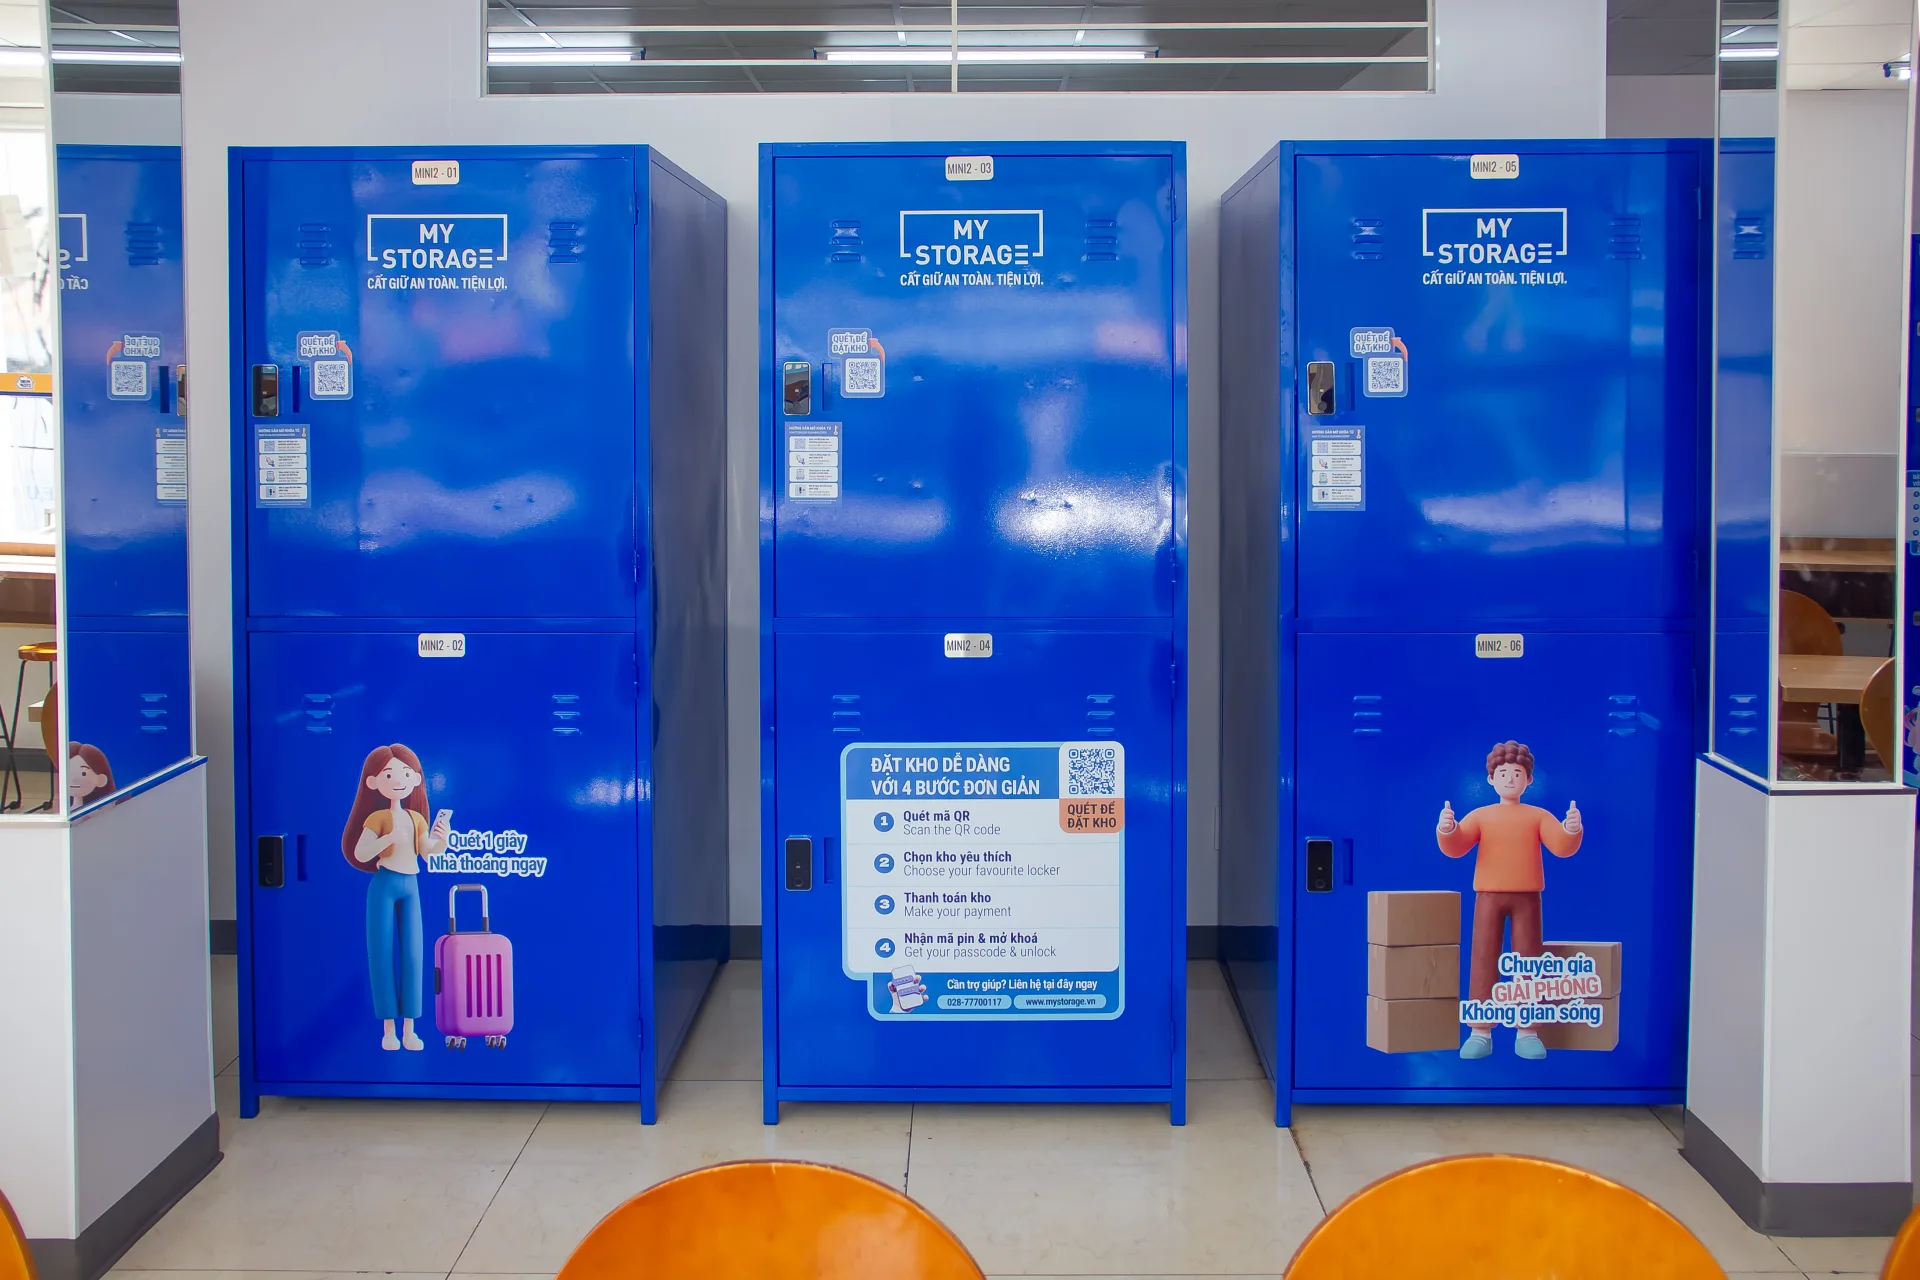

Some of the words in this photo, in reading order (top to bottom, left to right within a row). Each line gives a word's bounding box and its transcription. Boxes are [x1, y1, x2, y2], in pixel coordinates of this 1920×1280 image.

[415, 167, 438, 179] MINI2
[447, 167, 457, 179] 01
[948, 163, 971, 174] MINI2
[980, 163, 991, 174] 03
[1472, 162, 1496, 173] MINI2
[1506, 161, 1516, 173] 05
[420, 224, 454, 243] MY
[955, 220, 988, 239] MY
[1477, 218, 1511, 238] MY
[383, 249, 493, 268] STORAGE
[916, 245, 1028, 264] STORAGE
[1439, 244, 1552, 263] STORAGE
[368, 274, 388, 290] CẤT
[389, 275, 410, 290] GIỮ
[411, 279, 426, 290] AN
[427, 275, 459, 290] TOÀN.
[462, 276, 487, 291] TIỆN
[488, 277, 507, 291] LỢI.
[900, 269, 920, 286] CẤT
[922, 271, 944, 285] GIỮ
[945, 274, 959, 285] AN
[961, 270, 994, 285] TOÀN.
[996, 272, 1021, 287] TIỆN
[1024, 273, 1043, 287] LỢI.
[1423, 268, 1444, 285] CẤT
[1445, 270, 1466, 284] GIỮ
[1467, 273, 1483, 284] AN
[1485, 269, 1517, 284] TOÀN.
[1520, 271, 1545, 286] TIỆN
[1547, 272, 1567, 286] LỢI.
[302, 348, 317, 356] ĐẶT
[833, 344, 848, 353] ĐẶT
[1356, 344, 1370, 352] ĐẶT
[421, 640, 443, 651] MINI2
[452, 640, 463, 650] 02
[947, 640, 970, 651] MINI2
[980, 640, 990, 651] 04
[1478, 640, 1501, 651] MINI2
[1510, 640, 1521, 651] 06
[871, 754, 902, 776] ĐẶT
[905, 758, 938, 773] KHO
[943, 752, 963, 773] DỄ
[966, 754, 1010, 773] DÀNG
[872, 778, 898, 795] VỚI
[902, 780, 911, 795] 4
[916, 778, 960, 795] BƯỚC
[963, 779, 998, 795] ĐƠN
[1002, 776, 1040, 795] GIẢN
[1067, 803, 1097, 815] QUÉT
[1100, 801, 1115, 814] ĐỂ
[880, 817, 888, 826] 1
[903, 810, 930, 823] Quét
[933, 811, 950, 822] mã
[954, 811, 970, 822] QR
[1067, 817, 1091, 830] ĐẶT
[1093, 818, 1116, 828] KHO
[903, 824, 930, 835] Scan
[934, 824, 951, 835] the
[954, 824, 970, 837] QR
[974, 824, 1001, 835] code
[448, 832, 481, 849] Quét
[485, 834, 491, 847] 1
[496, 832, 525, 851] giây
[430, 856, 456, 870] Nhà
[460, 855, 508, 875] thoáng
[512, 860, 545, 875] ngay
[879, 858, 890, 868] 2
[904, 851, 933, 866] Chọn
[936, 851, 957, 862] kho
[960, 852, 980, 865] yêu
[984, 851, 1012, 862] thích
[904, 865, 945, 876] Choose
[948, 868, 972, 878] your
[976, 865, 1024, 876] favourite
[1027, 865, 1060, 876] locker
[879, 900, 890, 909] 3
[904, 892, 938, 903] Thanh
[942, 892, 967, 903] toán
[970, 892, 991, 903] kho
[904, 906, 934, 917] Make
[937, 909, 960, 919] your
[964, 907, 1011, 919] payment
[904, 933, 933, 946] Nhận
[937, 934, 954, 944] mã
[957, 933, 974, 946] pin
[978, 933, 986, 944] &
[989, 932, 1007, 944] mở
[1011, 932, 1038, 944] khoá
[880, 943, 890, 953] 4
[904, 947, 924, 957] Get
[927, 949, 950, 960] your
[954, 946, 1006, 960] passcode
[1010, 947, 1017, 957] &
[1021, 946, 1056, 957] unlock
[1501, 955, 1563, 976] Chuyên
[1568, 956, 1592, 976] gia
[947, 978, 965, 990] Cần
[967, 980, 980, 992] trợ
[982, 980, 1007, 992] giúp?
[1009, 980, 1028, 990] Liên
[1030, 980, 1041, 992] hệ
[1043, 980, 1054, 992] tại
[1057, 979, 1073, 992] đây
[1076, 981, 1097, 992] ngay
[1495, 978, 1530, 1001] GIẢI
[1535, 974, 1599, 999] PHÓNG
[947, 997, 1002, 1007] 028-77700117
[1026, 997, 1096, 1008] www.mystorage.vn
[1463, 1004, 1515, 1023] Không
[1520, 1004, 1555, 1024] gian
[1559, 1001, 1600, 1024] sống
